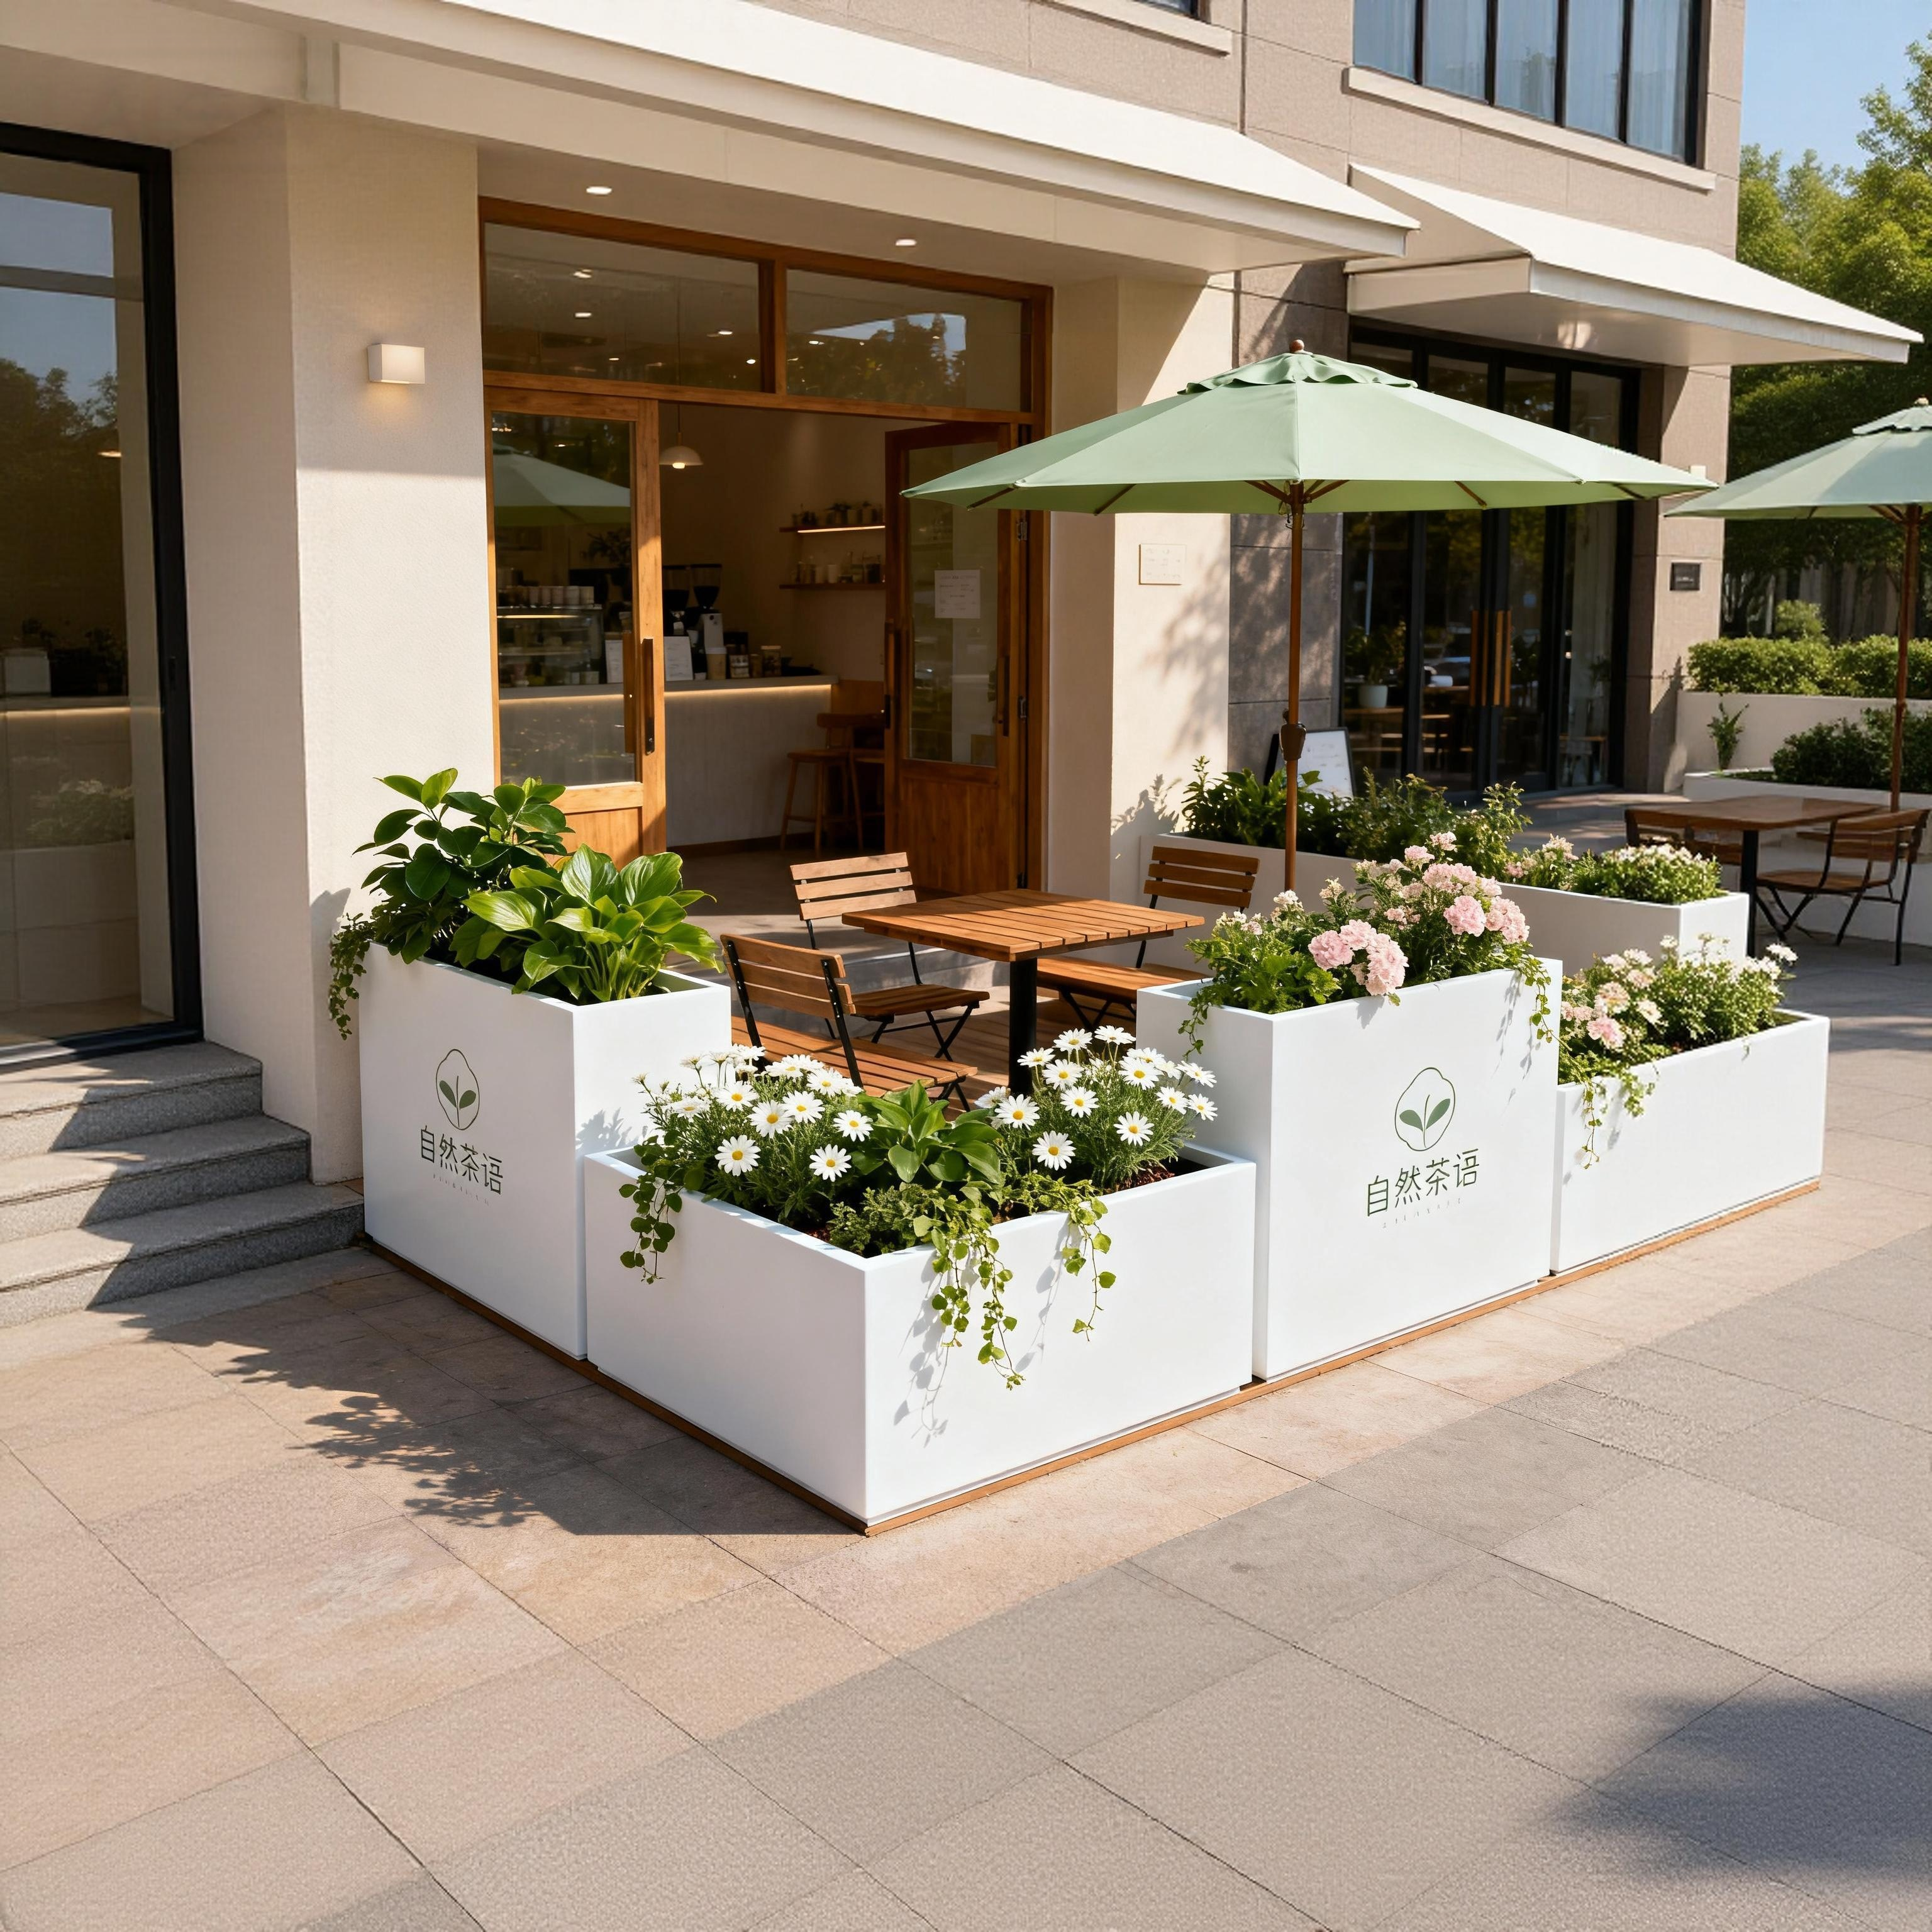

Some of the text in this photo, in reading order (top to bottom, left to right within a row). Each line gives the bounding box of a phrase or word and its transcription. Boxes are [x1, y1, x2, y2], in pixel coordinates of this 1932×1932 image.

[421, 1125, 502, 1195] 自然茶语
[1367, 1148, 1479, 1216] 自然茶语
